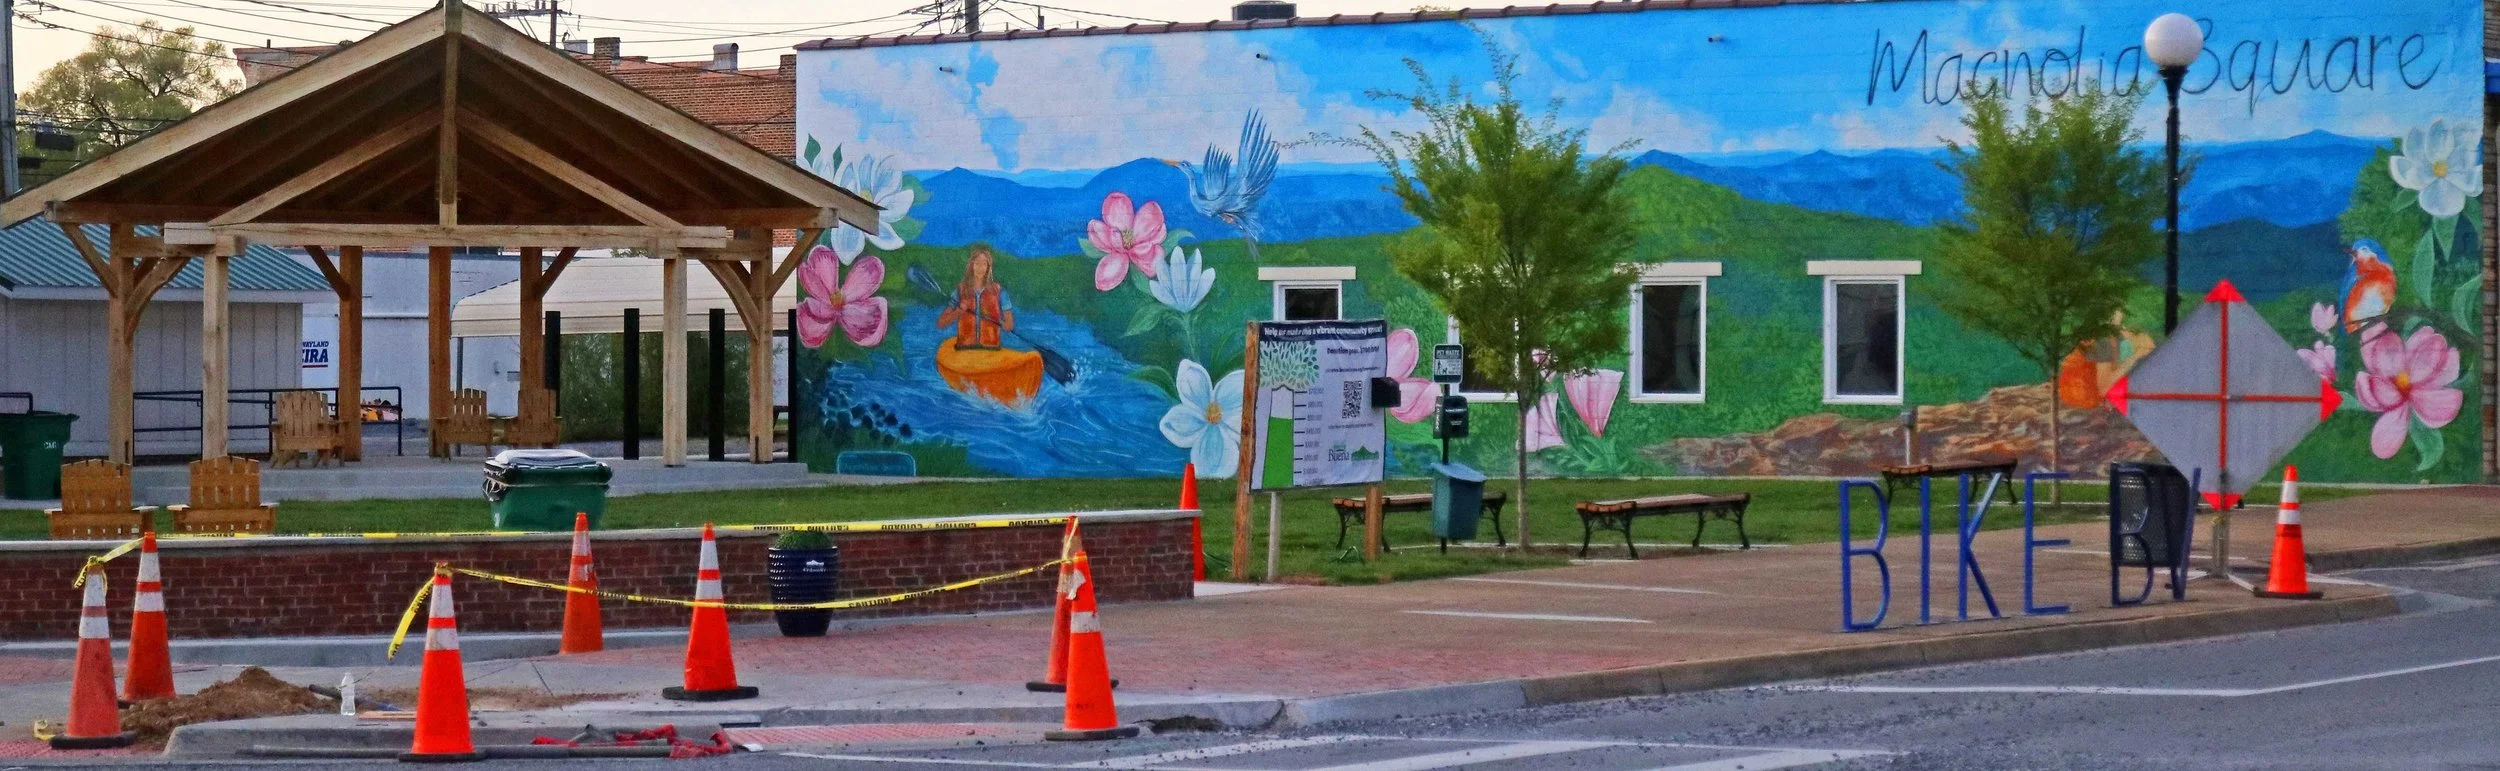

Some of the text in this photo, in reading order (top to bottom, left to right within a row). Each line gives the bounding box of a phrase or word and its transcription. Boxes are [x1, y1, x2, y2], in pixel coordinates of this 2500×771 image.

[1264, 327, 1278, 337] Help
[1302, 327, 1312, 335] this
[1316, 325, 1336, 335] vibrant
[1336, 326, 1367, 336] community
[1840, 472, 2071, 632] BIKE
